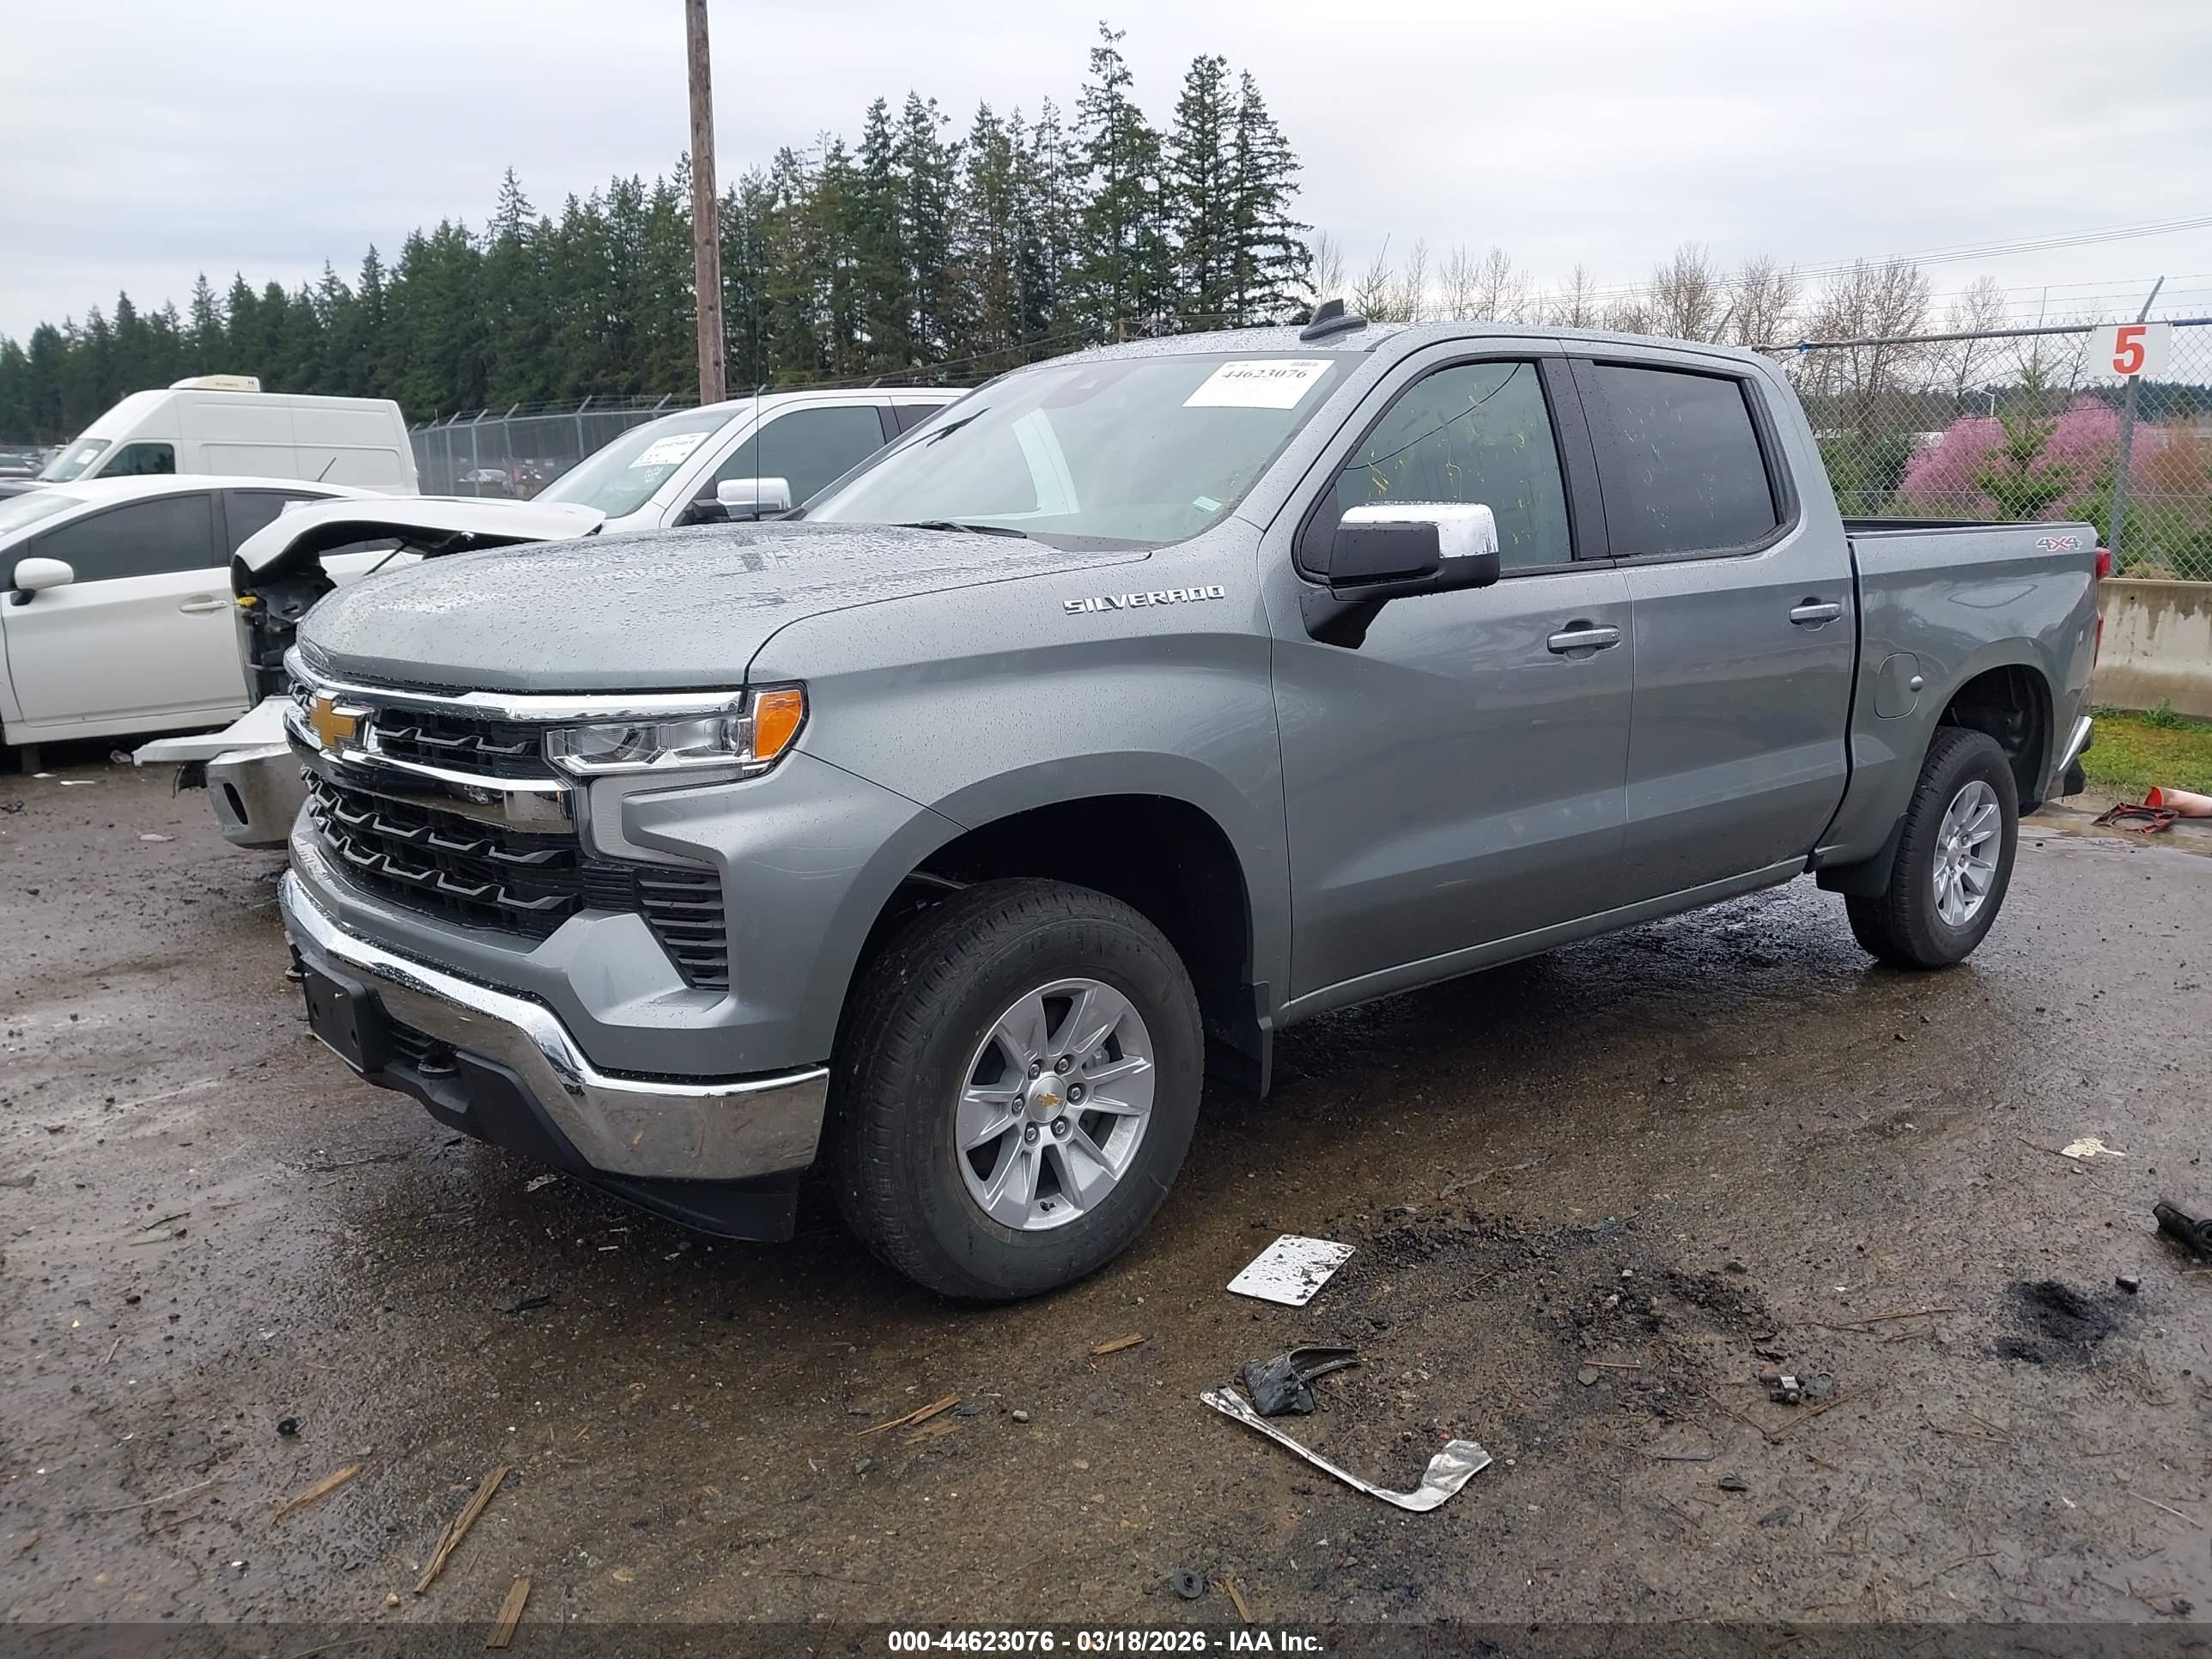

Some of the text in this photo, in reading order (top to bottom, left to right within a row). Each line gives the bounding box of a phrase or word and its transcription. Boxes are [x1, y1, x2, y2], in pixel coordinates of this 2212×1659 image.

[2112, 325, 2147, 374] 5
[1222, 369, 1308, 379] 44623076
[1063, 585, 1225, 616] SILVERADO
